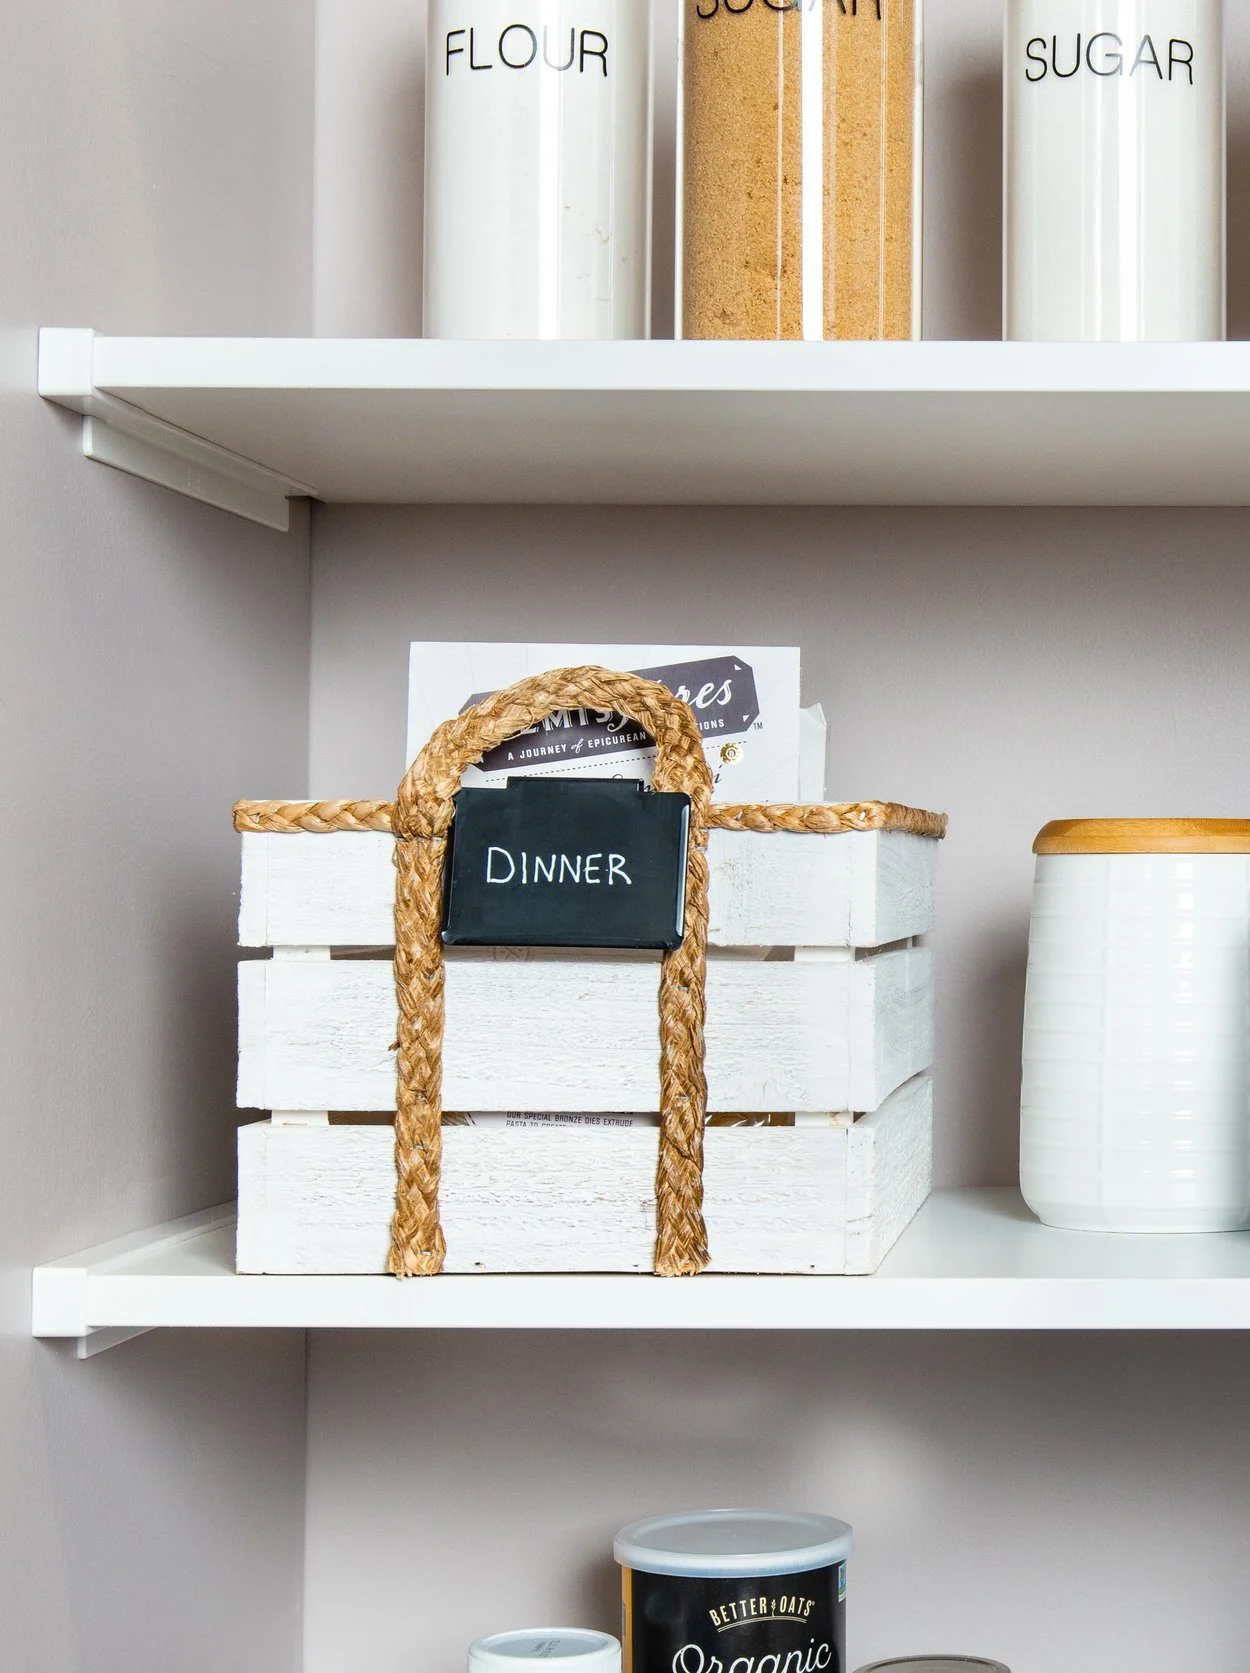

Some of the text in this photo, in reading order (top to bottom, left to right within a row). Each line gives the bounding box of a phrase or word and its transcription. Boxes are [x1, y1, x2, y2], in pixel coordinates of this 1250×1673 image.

[446, 24, 608, 77] FLOUR
[1026, 32, 1194, 85] SUGAR
[508, 732, 647, 761] A JOURNEY of EPICUREAN
[487, 847, 631, 886] DINNER
[524, 1112, 550, 1121] SPECIAL
[555, 1114, 582, 1123] BRONZE
[585, 1117, 600, 1125] DIES
[709, 1597, 767, 1627] BETTER
